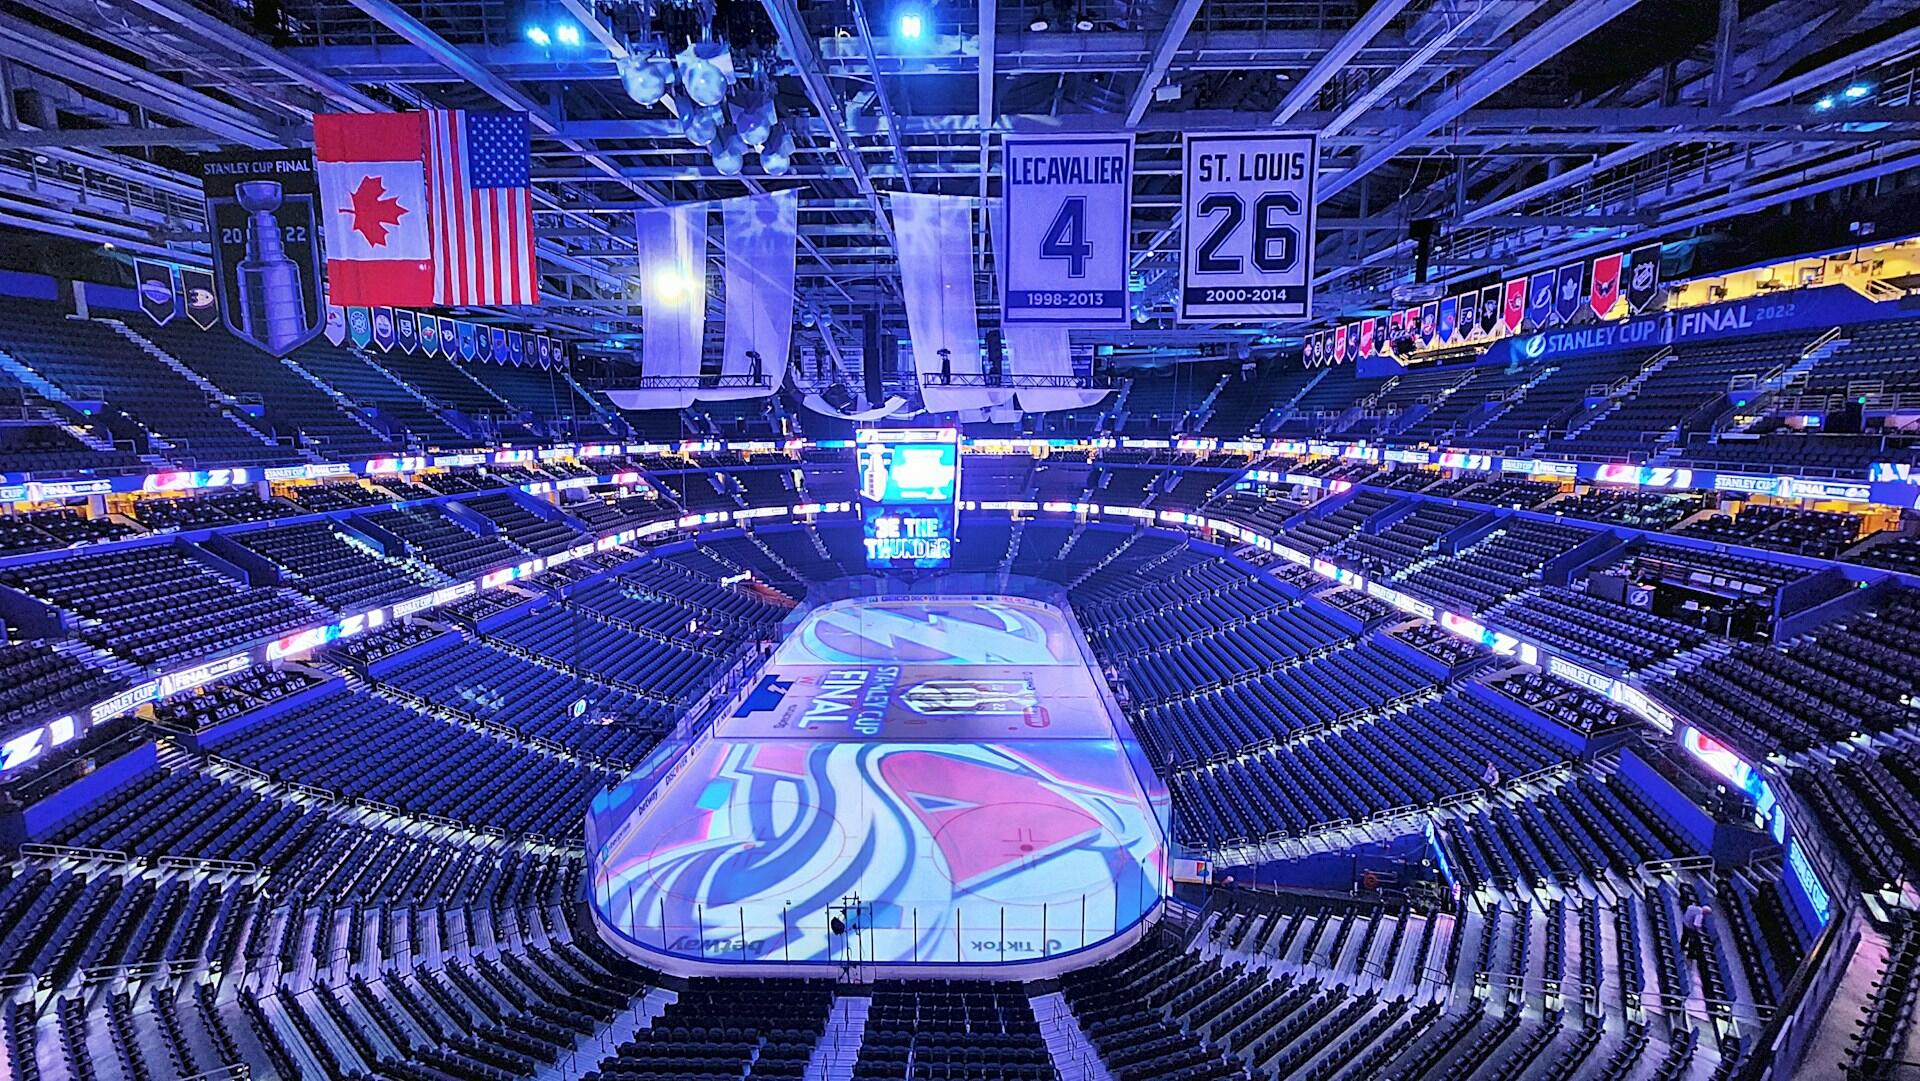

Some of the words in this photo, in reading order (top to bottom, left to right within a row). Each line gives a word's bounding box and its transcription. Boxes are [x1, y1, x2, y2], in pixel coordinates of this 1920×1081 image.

[203, 162, 250, 175] STANLEY
[252, 161, 273, 173] CUP
[275, 160, 311, 172] FINAL
[1012, 155, 1124, 185] LECAVALIER
[1199, 153, 1231, 182] ST.
[1239, 152, 1305, 182] LOUIS
[222, 227, 242, 243] 20
[285, 226, 306, 242] 22
[1039, 195, 1093, 279] 4
[1195, 190, 1302, 274] 26
[1027, 292, 1104, 306] 1998-2013
[1206, 288, 1287, 302] 2000-2014
[1549, 323, 1616, 352] STANLEY
[1619, 320, 1655, 343] CUP
[1681, 305, 1753, 337] FINAL
[1756, 303, 1796, 321] 2022
[0, 488, 24, 498] CUP
[1715, 477, 1755, 490] STANLEY
[1756, 480, 1777, 490] CUP
[1792, 483, 1827, 495] FINAL
[904, 518, 938, 538] THE
[863, 537, 951, 559] THUNDER
[863, 667, 899, 708] STANLEY
[1550, 660, 1589, 683] STANLEY
[1590, 675, 1612, 690] CUP
[92, 693, 135, 722] STANLEY
[134, 685, 157, 703] CUP
[176, 666, 211, 686] FINAL
[798, 670, 869, 728] FINAL
[853, 710, 883, 735] CUP
[638, 789, 659, 816] betway
[668, 935, 766, 955] betway
[971, 941, 1035, 952] TikTok
